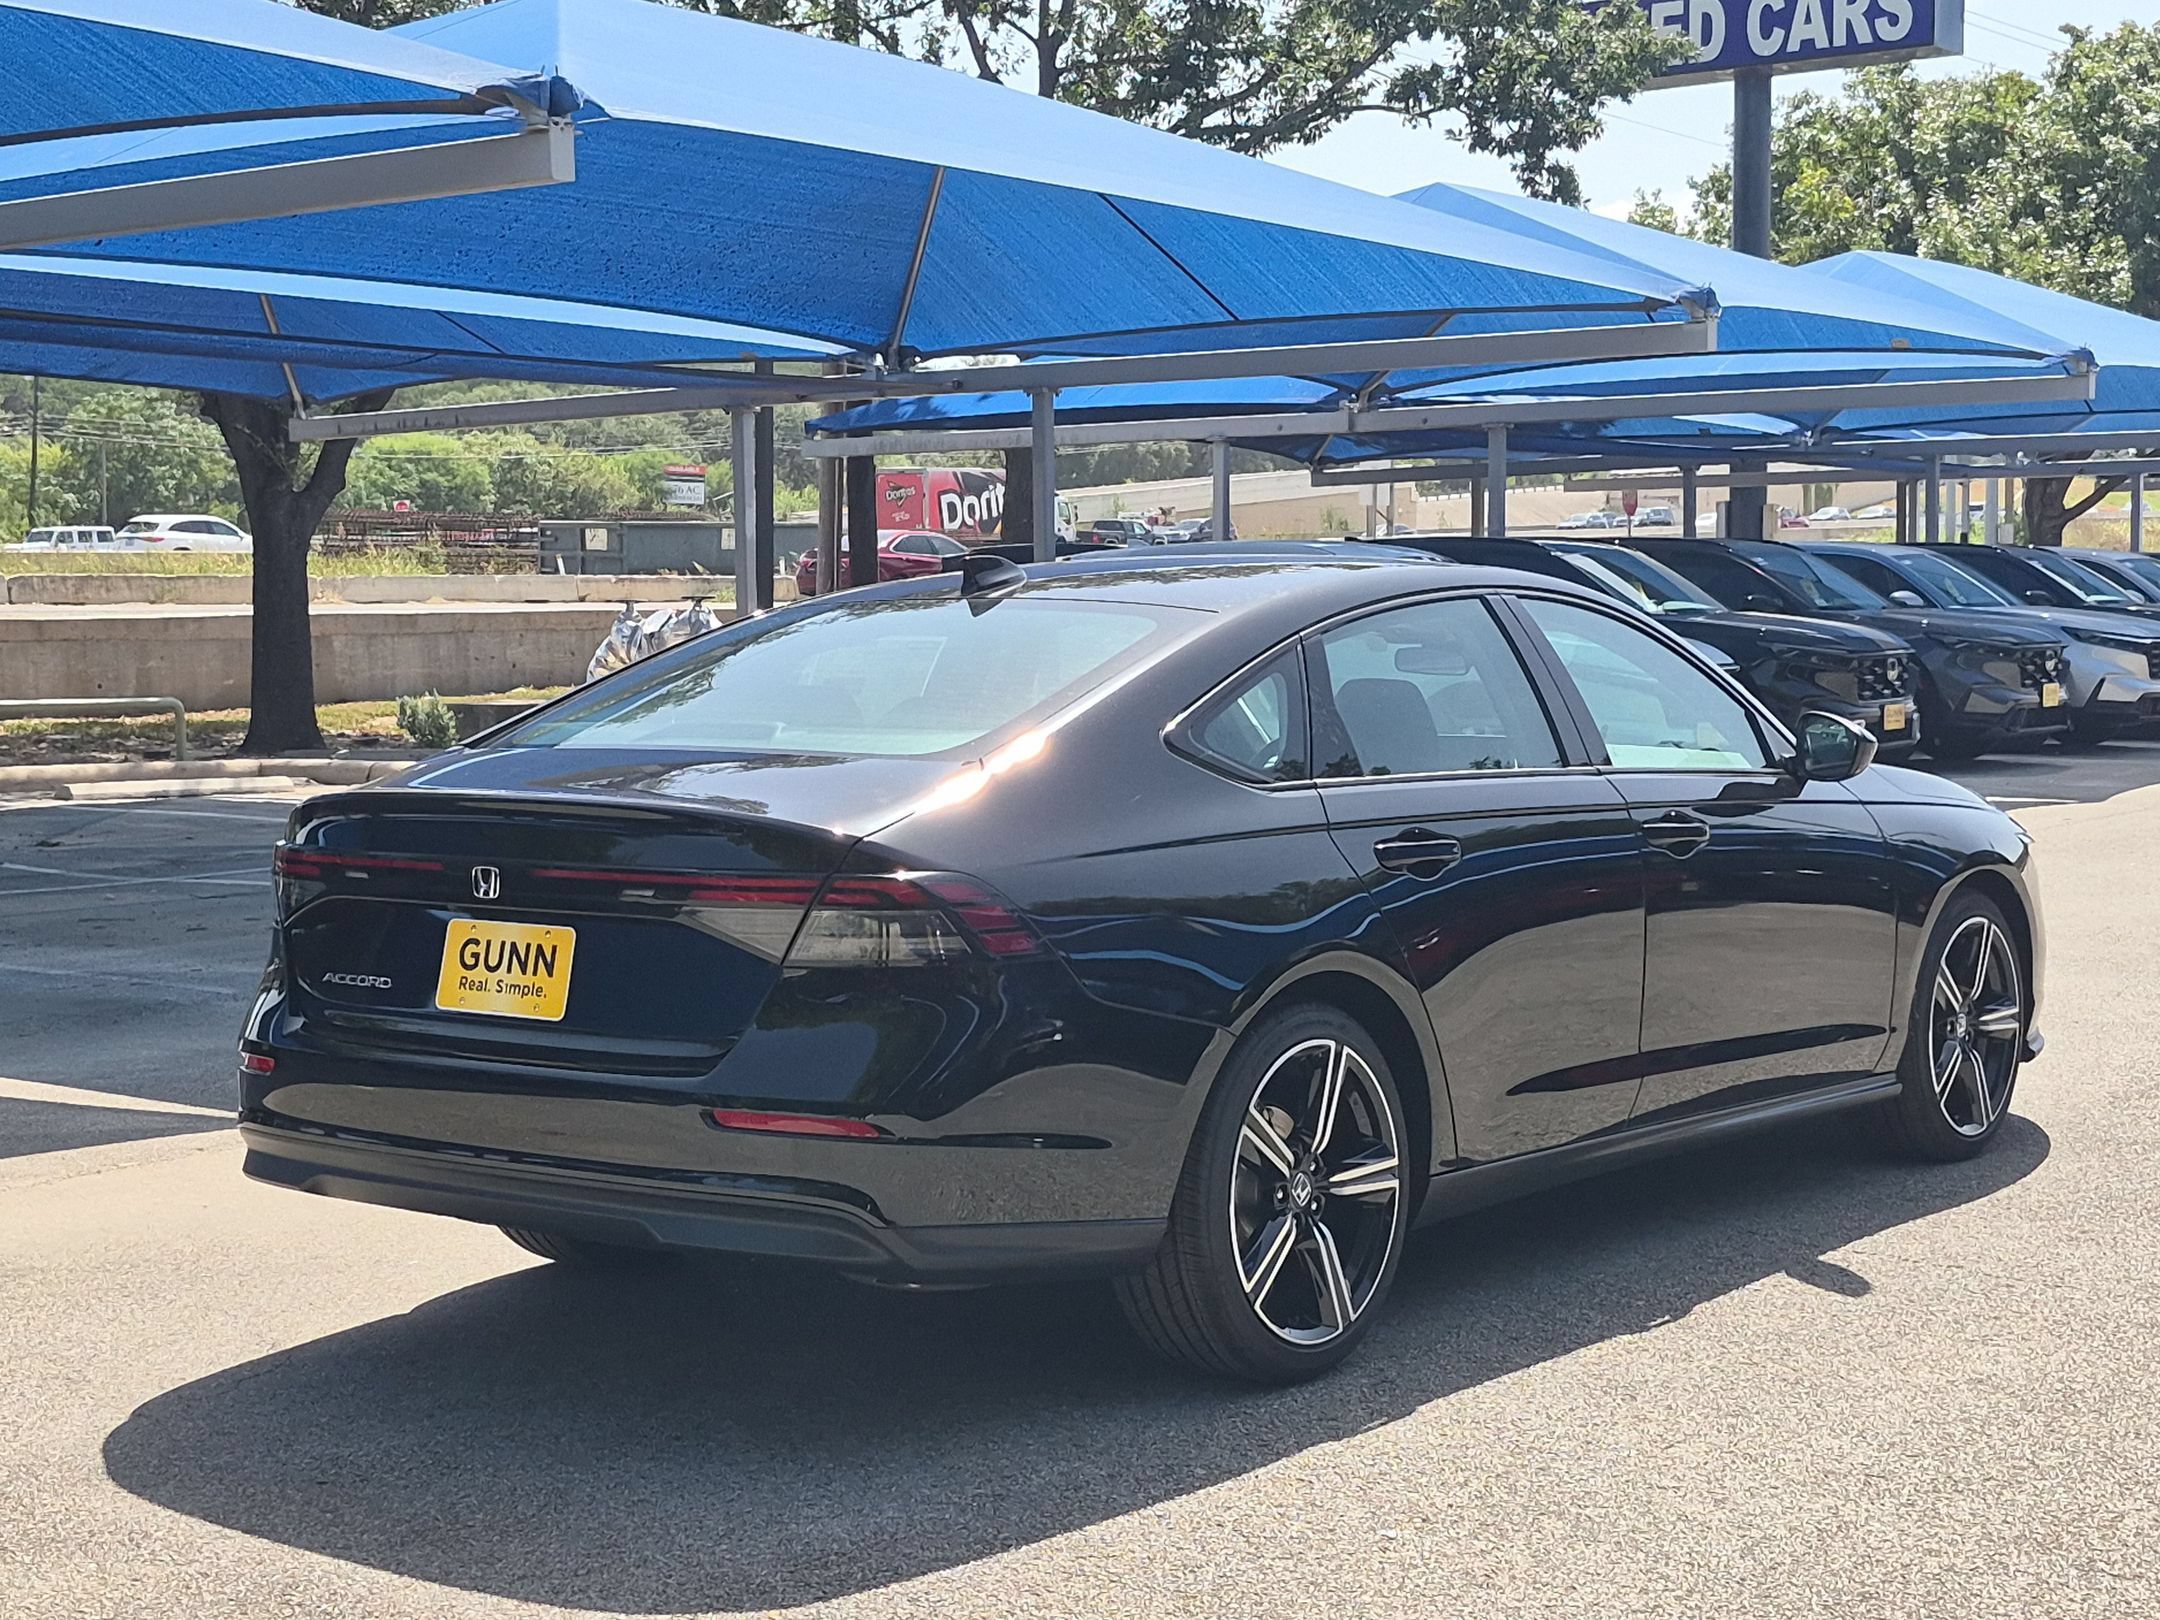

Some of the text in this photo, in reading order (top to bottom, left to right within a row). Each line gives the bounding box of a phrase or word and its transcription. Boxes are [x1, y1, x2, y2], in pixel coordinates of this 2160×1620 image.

[1747, 0, 1914, 56] CARS
[940, 482, 1006, 530] Dorit
[459, 937, 558, 978] GUNN
[322, 972, 392, 989] ACCORD
[458, 975, 547, 999] Real. Simple.
